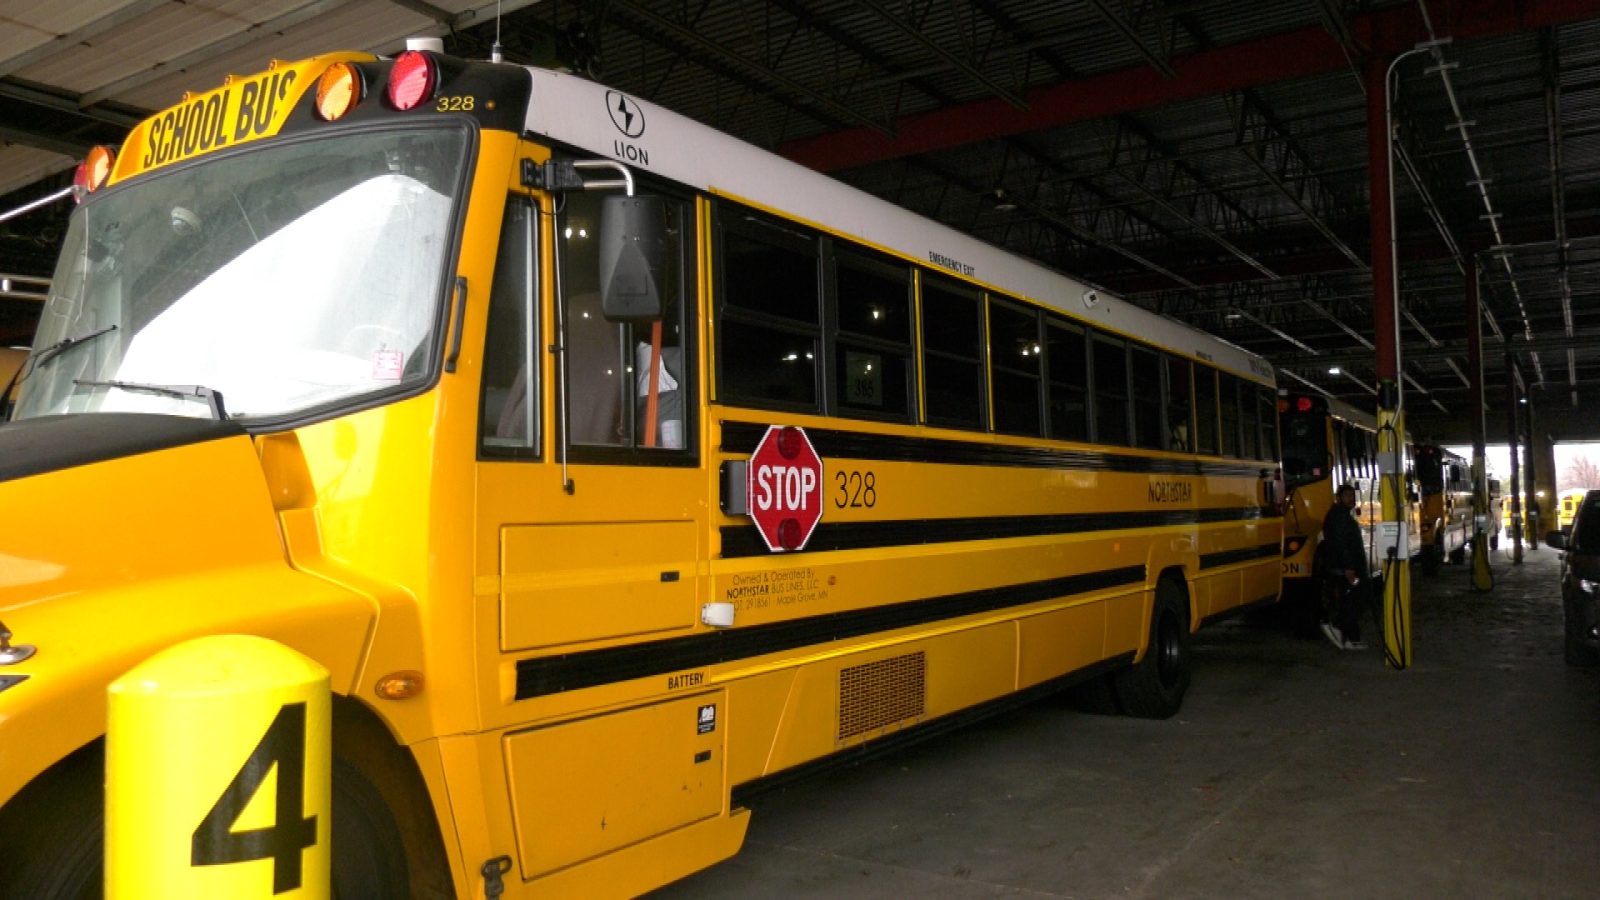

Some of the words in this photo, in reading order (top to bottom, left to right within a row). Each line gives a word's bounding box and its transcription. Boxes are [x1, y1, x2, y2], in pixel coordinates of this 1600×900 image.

[436, 95, 475, 113] 328
[144, 90, 230, 169] SCHOOL
[614, 139, 649, 165] LION
[929, 251, 962, 273] EMERGENCY
[963, 264, 975, 278] EXIT
[757, 464, 816, 511] STOP
[834, 471, 876, 508] 328
[1148, 481, 1192, 504] NORTHSTAR
[733, 573, 762, 585] Owned
[764, 572, 769, 582] &
[771, 568, 806, 583] Operated
[807, 567, 815, 580] By
[726, 584, 769, 600] NORTHSTAR
[771, 582, 784, 594] BUS
[806, 578, 819, 590] LLC
[776, 594, 796, 606] Maple
[818, 589, 829, 600] MN
[668, 672, 705, 690] BATTERY
[190, 701, 318, 896] 4
